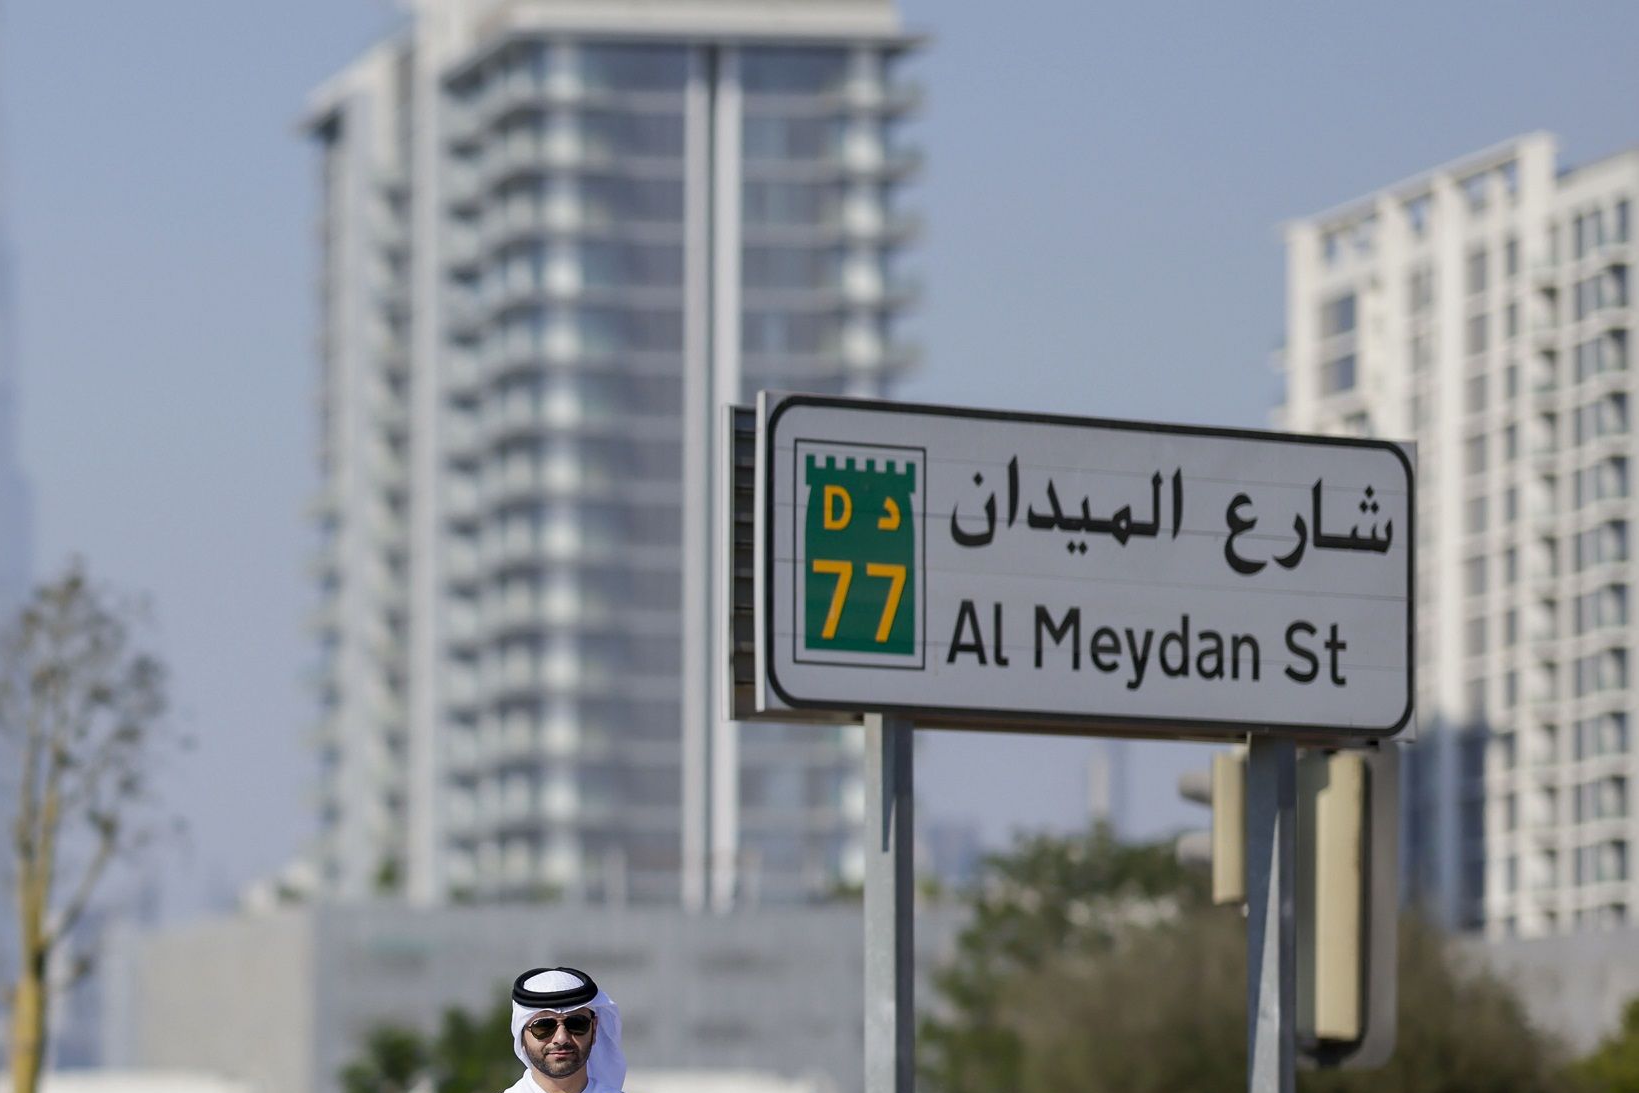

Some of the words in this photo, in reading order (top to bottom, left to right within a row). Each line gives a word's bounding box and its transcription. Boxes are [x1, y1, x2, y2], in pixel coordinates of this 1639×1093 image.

[823, 485, 852, 530] D
[949, 454, 1184, 556] الميدان
[1223, 477, 1394, 577] شارع
[812, 559, 906, 643] 77
[945, 598, 1010, 669] Al
[1033, 604, 1262, 692] Meydan
[1283, 619, 1349, 688] St
